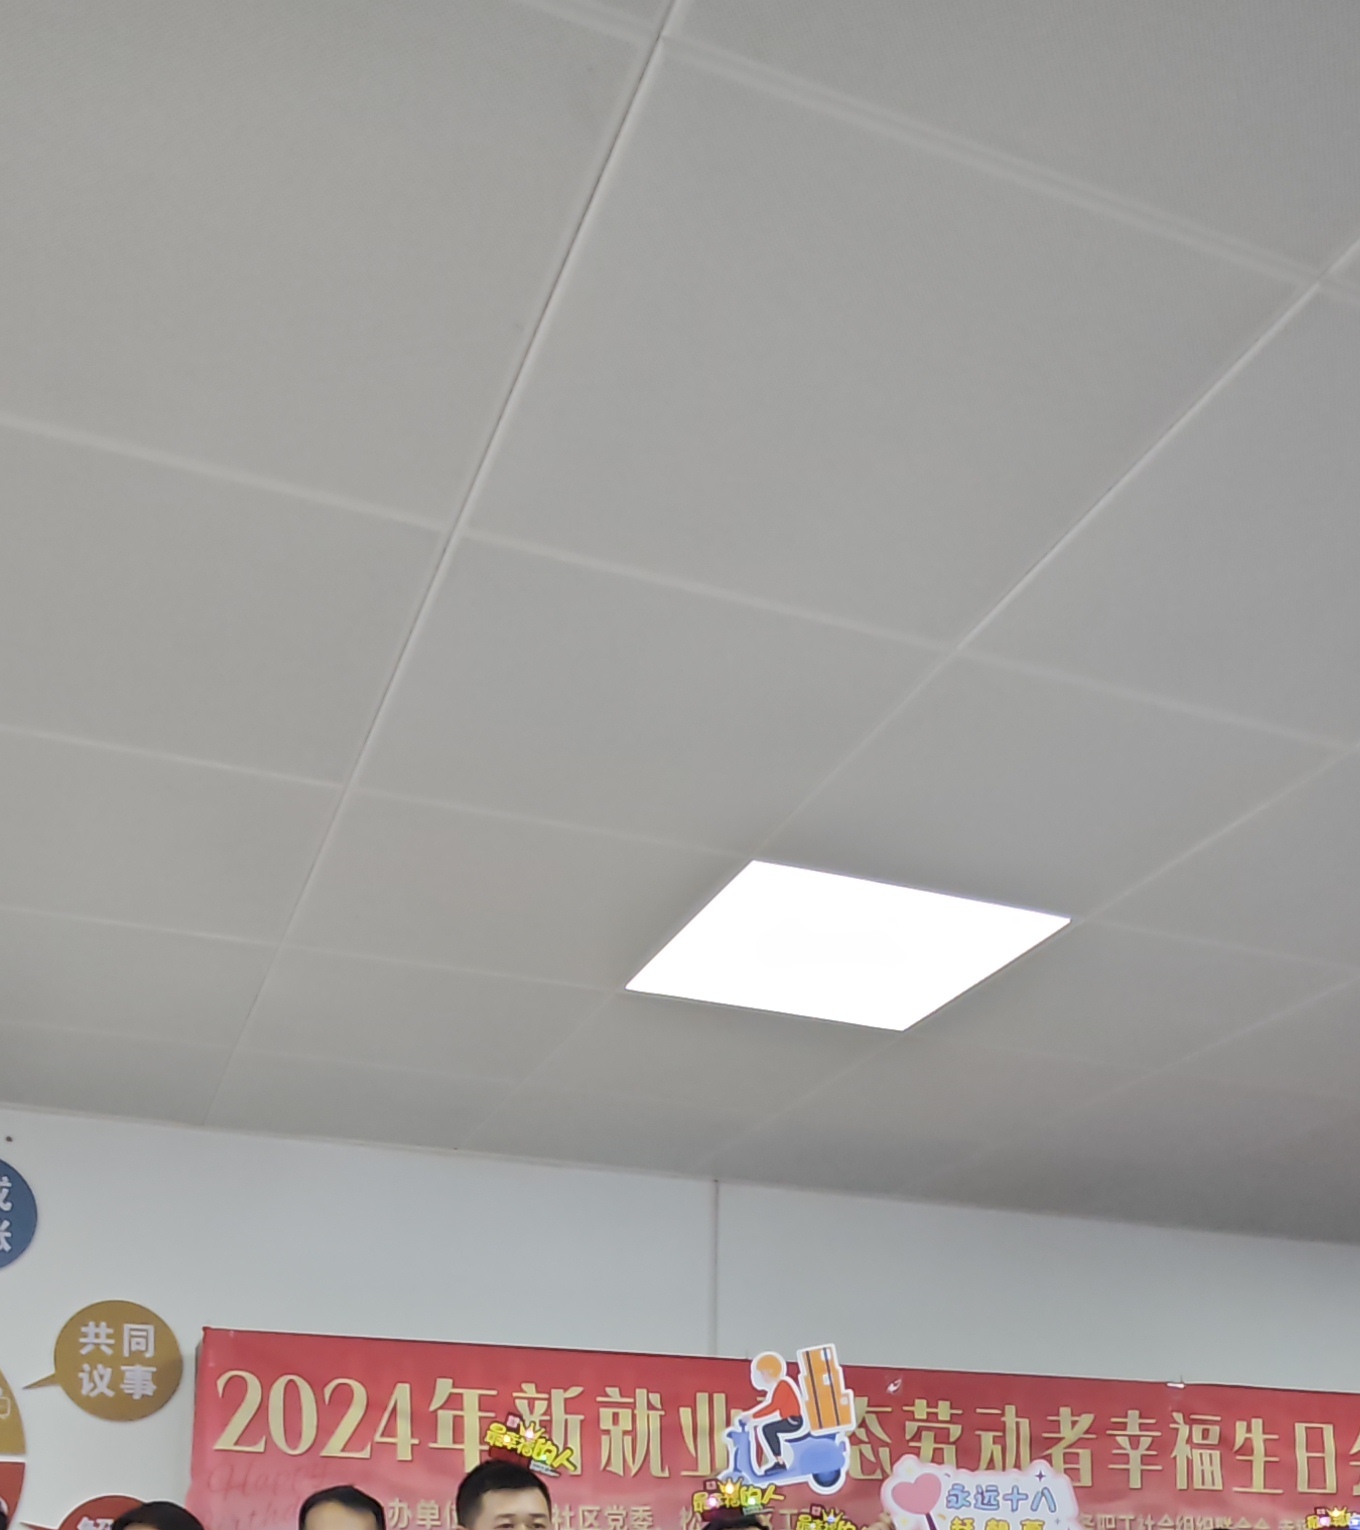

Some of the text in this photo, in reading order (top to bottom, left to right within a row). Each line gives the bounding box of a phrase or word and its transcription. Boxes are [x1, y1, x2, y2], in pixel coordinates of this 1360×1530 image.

[78, 1320, 156, 1359] 共同
[77, 1362, 158, 1400] 议事
[946, 1483, 1058, 1514] 永远十八
